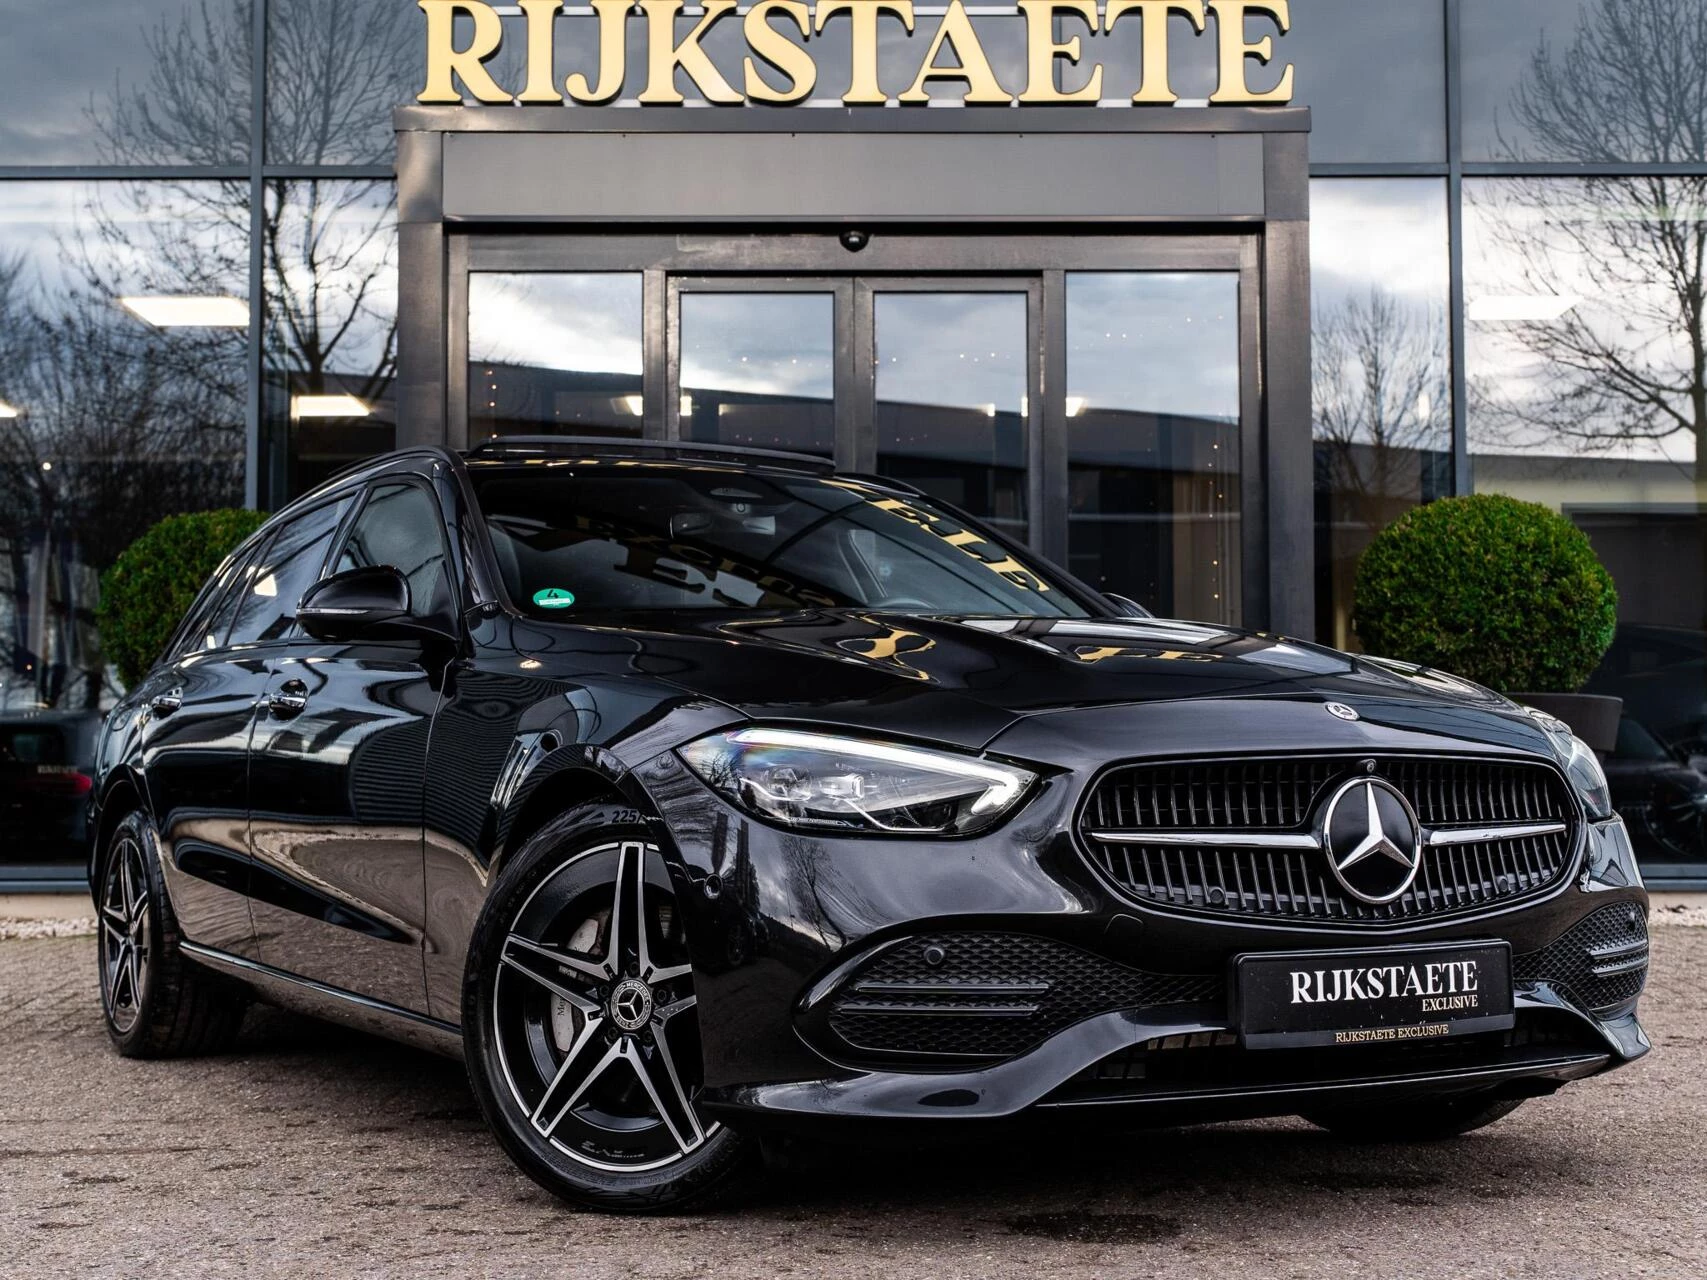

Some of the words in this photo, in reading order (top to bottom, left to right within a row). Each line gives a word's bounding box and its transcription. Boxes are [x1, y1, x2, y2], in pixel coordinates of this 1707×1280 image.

[417, 0, 1294, 104] RIJKSTAETE
[1290, 961, 1478, 1003] RIJKSTAETE
[1422, 995, 1478, 1012] EXCLUSIVE
[1335, 1029, 1396, 1043] RIJKSTAETE
[1398, 1024, 1449, 1039] EXCLUSIVE
